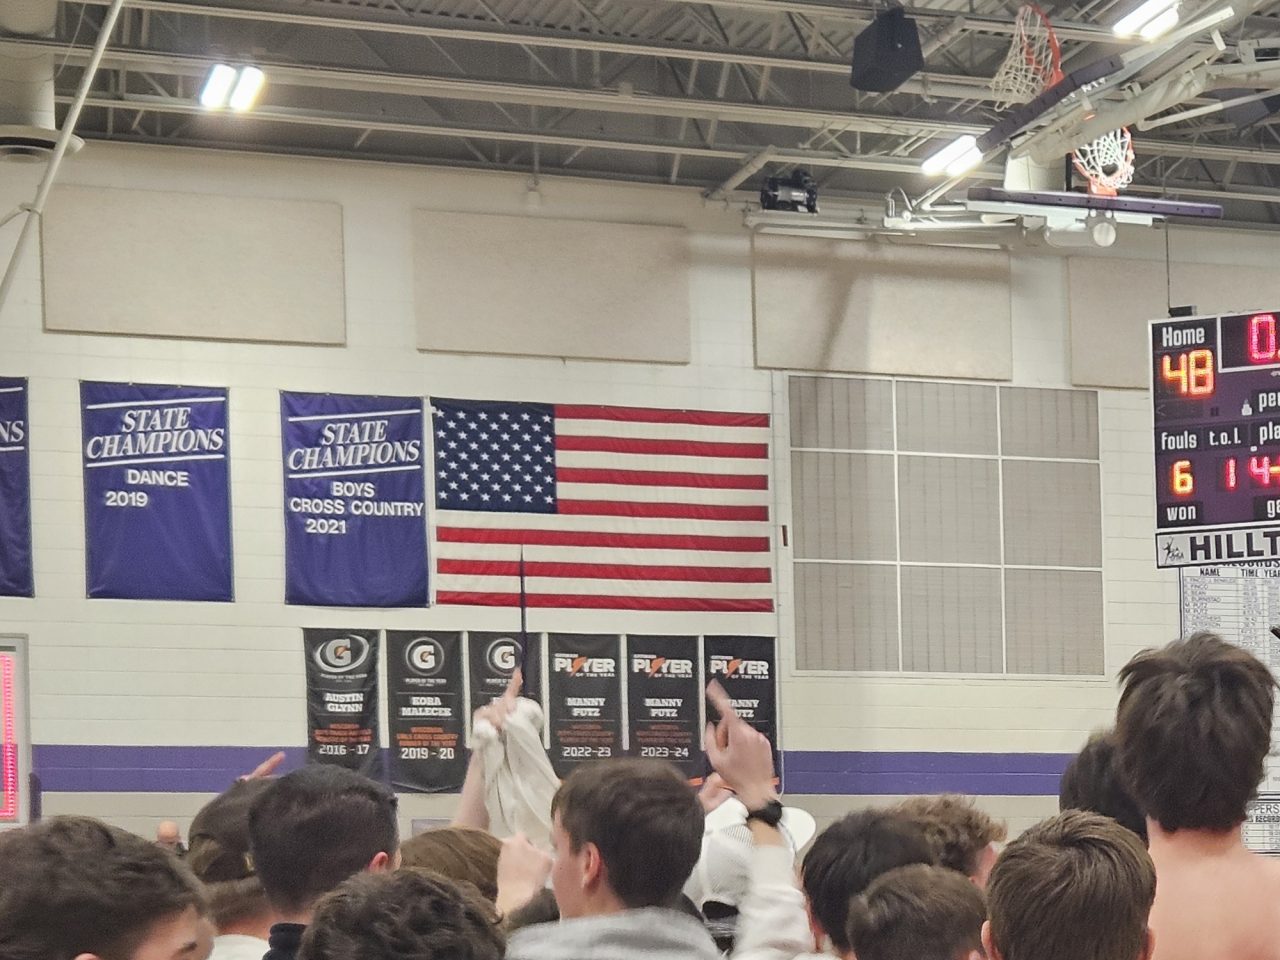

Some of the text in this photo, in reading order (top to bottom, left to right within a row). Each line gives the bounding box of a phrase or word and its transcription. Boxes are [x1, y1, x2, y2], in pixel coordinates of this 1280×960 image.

[1162, 327, 1205, 347] Home
[1163, 350, 1214, 394] 48
[121, 407, 191, 434] STATE
[322, 420, 388, 445] STATE
[86, 428, 225, 459] CHAMPIONS
[1162, 432, 1197, 450] fouls
[288, 440, 420, 471] CHAMPIONS
[127, 469, 189, 487] DANCE
[1173, 461, 1193, 493] 6
[332, 481, 375, 498] BOYS
[105, 491, 148, 506] 2019
[290, 499, 424, 517] CROSS COUNTRY
[1167, 505, 1196, 521] won
[306, 519, 346, 534] 2021
[1200, 569, 1221, 577] NAME
[1241, 569, 1259, 577] TIME
[413, 645, 435, 669] G
[325, 693, 364, 702] AUSTIN
[566, 698, 606, 706] MANNY
[645, 699, 683, 707] MANNY
[730, 700, 759, 708] ANNY
[327, 703, 363, 712] GLYNN
[651, 709, 678, 717] PUTZ
[735, 709, 755, 718] UTZ
[319, 745, 346, 755] 2016
[357, 744, 370, 755] 17
[401, 748, 428, 759] 2019
[440, 748, 454, 759] 20
[563, 747, 612, 757] 2022-23
[641, 747, 689, 757] 2023-24
